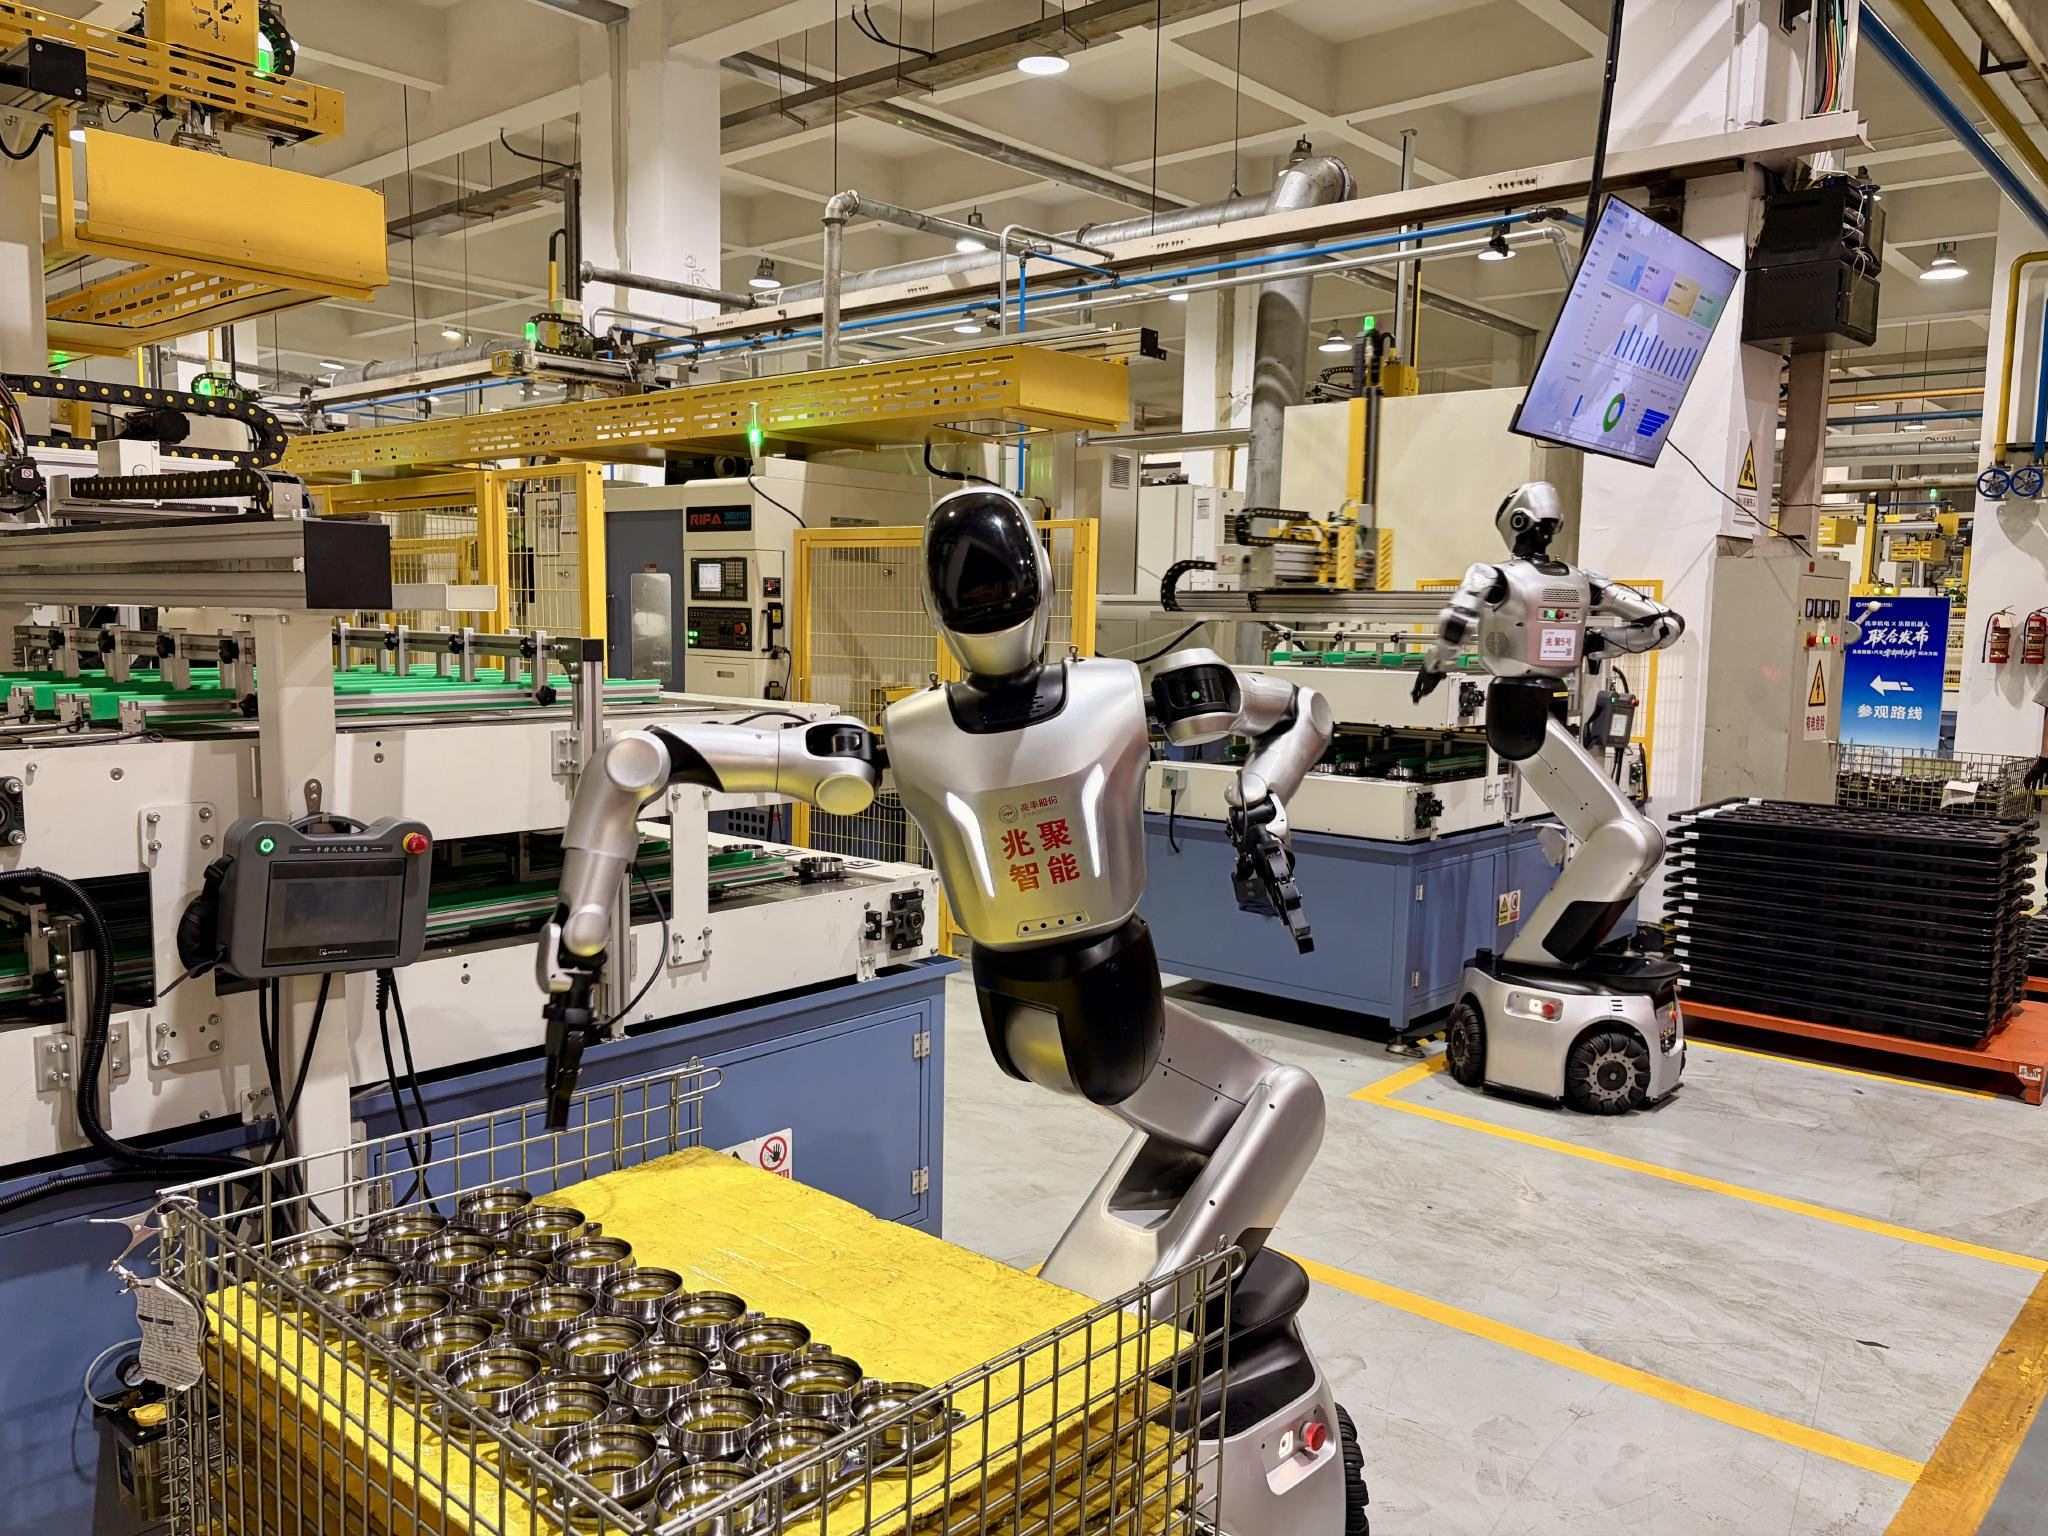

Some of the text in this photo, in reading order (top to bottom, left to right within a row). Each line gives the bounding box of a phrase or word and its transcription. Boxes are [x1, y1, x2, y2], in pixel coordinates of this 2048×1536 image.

[690, 513, 721, 525] RIFA
[1863, 626, 1929, 651] 联合发布
[1857, 703, 1923, 720] 参观路线
[1000, 818, 1073, 860] 兆聚
[1009, 852, 1080, 892] 智能
